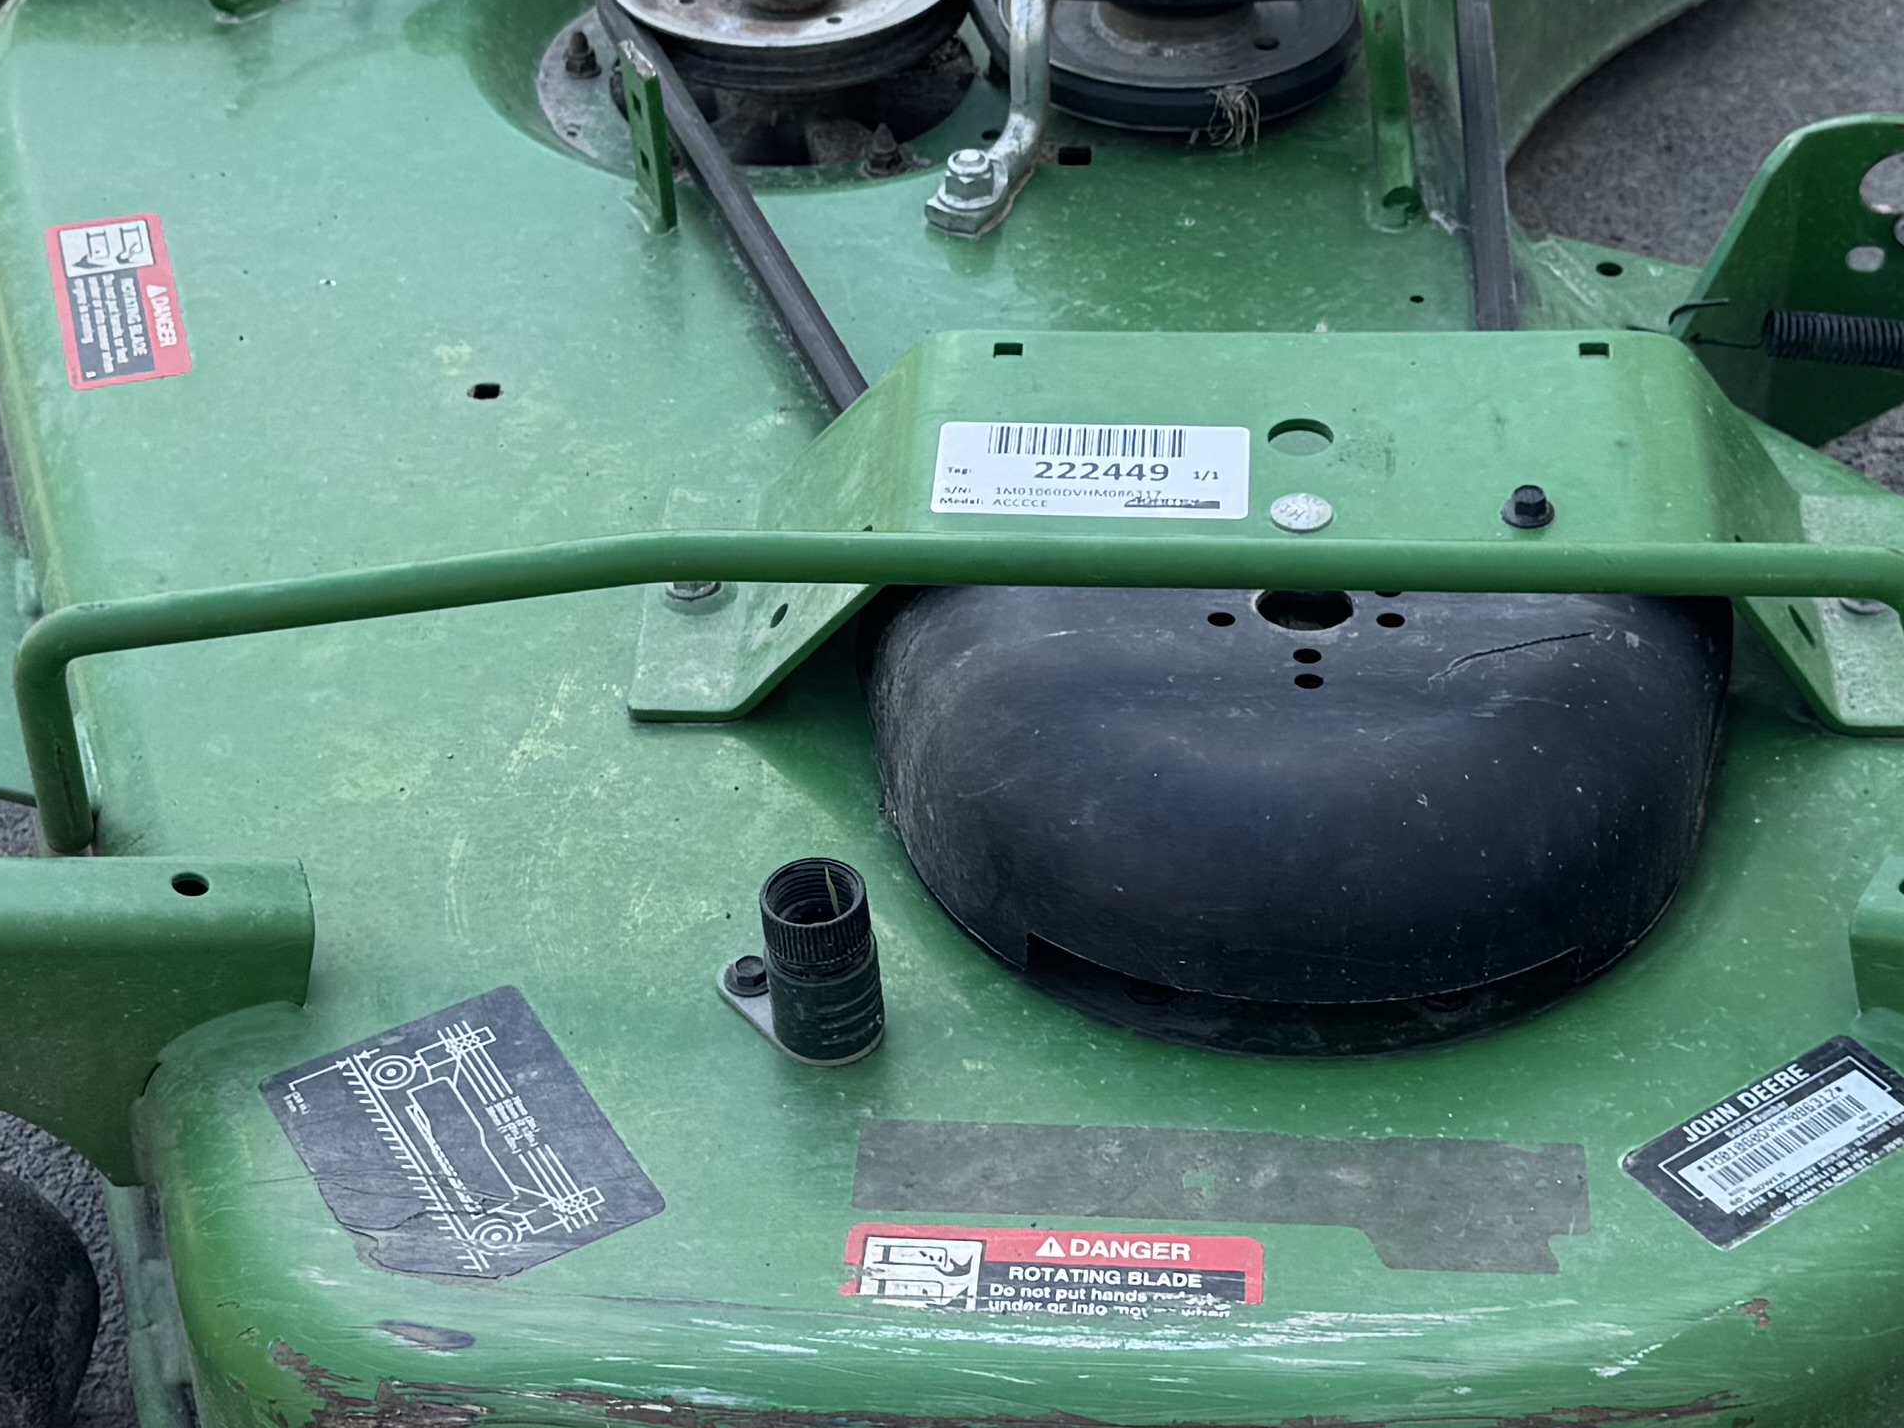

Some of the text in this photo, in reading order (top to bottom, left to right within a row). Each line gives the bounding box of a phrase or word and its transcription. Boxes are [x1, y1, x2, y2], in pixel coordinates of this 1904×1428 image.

[150, 295, 177, 347] DANGER
[1034, 461, 1169, 482] 222449
[1193, 470, 1219, 481] 1/1
[939, 497, 984, 505] Model:
[1681, 1063, 1810, 1142] JOHN DEERE
[1070, 1239, 1191, 1261] DANGER
[1008, 1266, 1203, 1288] ROTATING BLADE
[989, 1283, 1016, 1297] Do
[1020, 1285, 1051, 1299] not
[1055, 1288, 1086, 1302] put
[1090, 1287, 1148, 1303] hands
[988, 1299, 1042, 1313] under
[1071, 1302, 1108, 1317] into
